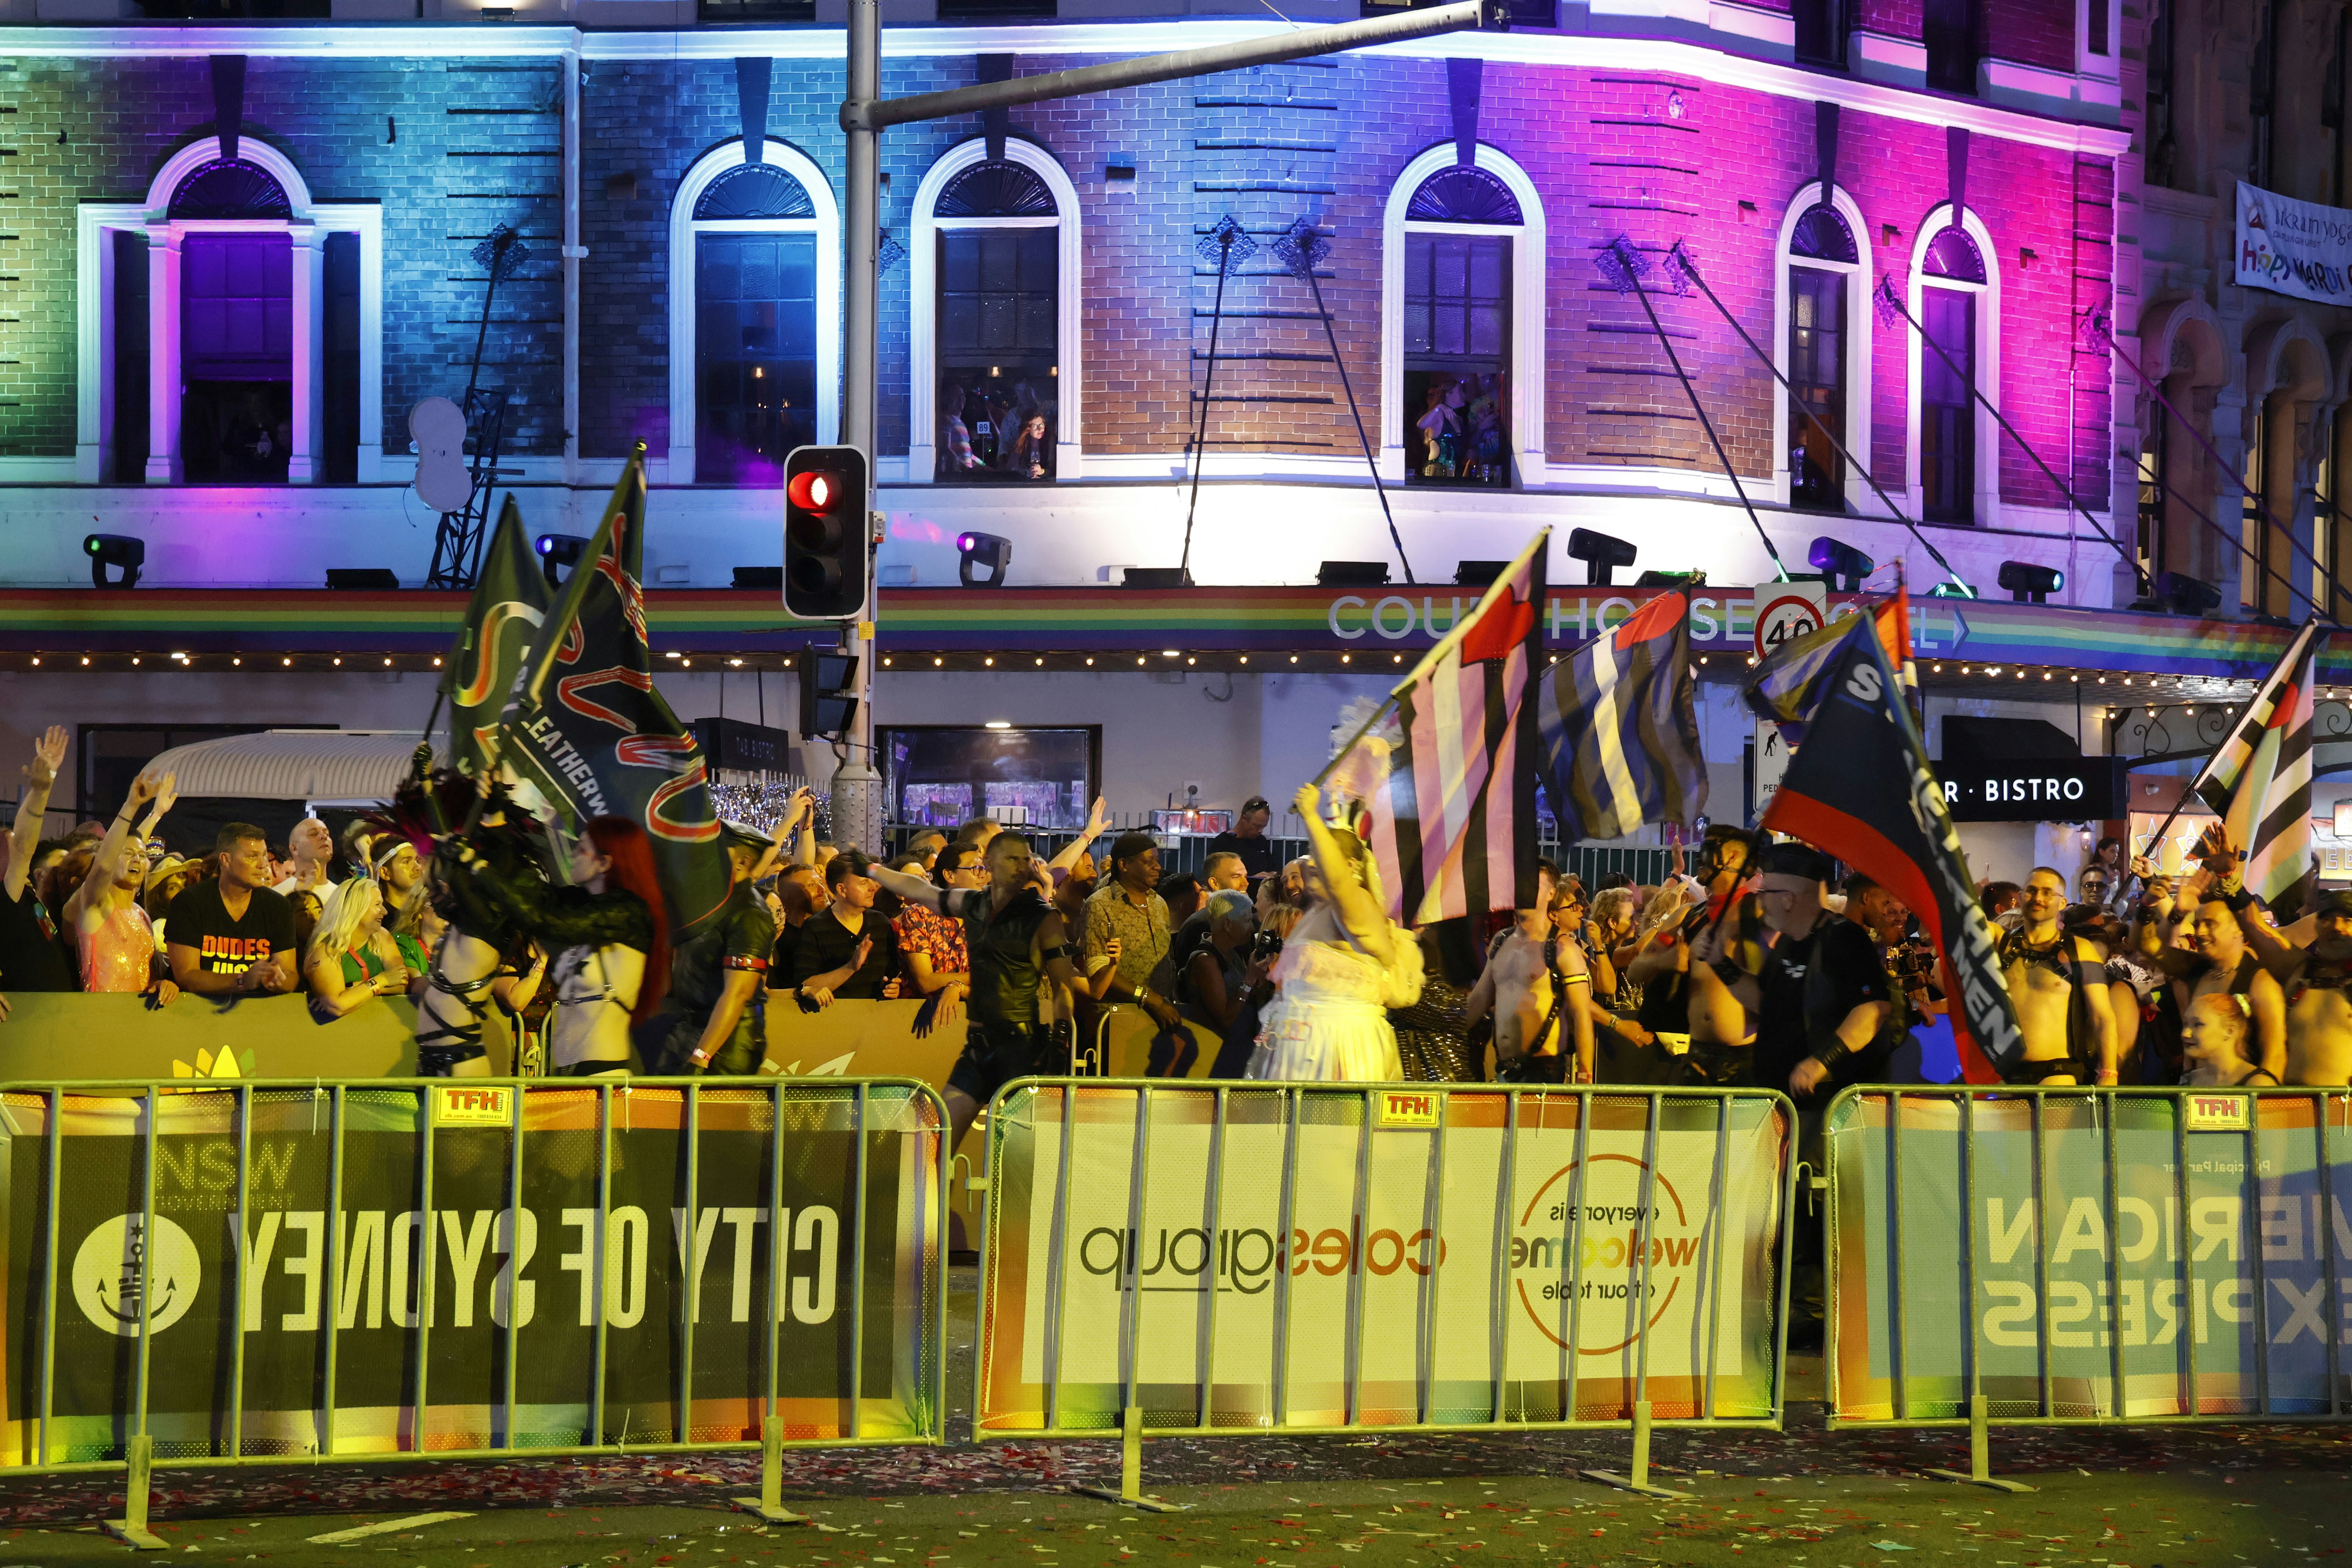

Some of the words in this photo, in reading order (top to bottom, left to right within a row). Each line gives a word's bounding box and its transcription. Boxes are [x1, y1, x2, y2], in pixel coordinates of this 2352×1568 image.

[979, 423, 988, 432] 89
[1985, 778, 2084, 802] BISTRO
[201, 935, 270, 960] DUDES
[447, 1090, 498, 1111] TFH
[1387, 1096, 1429, 1114] TFH
[2194, 1098, 2236, 1116] TFH
[155, 1142, 296, 1190] NSW
